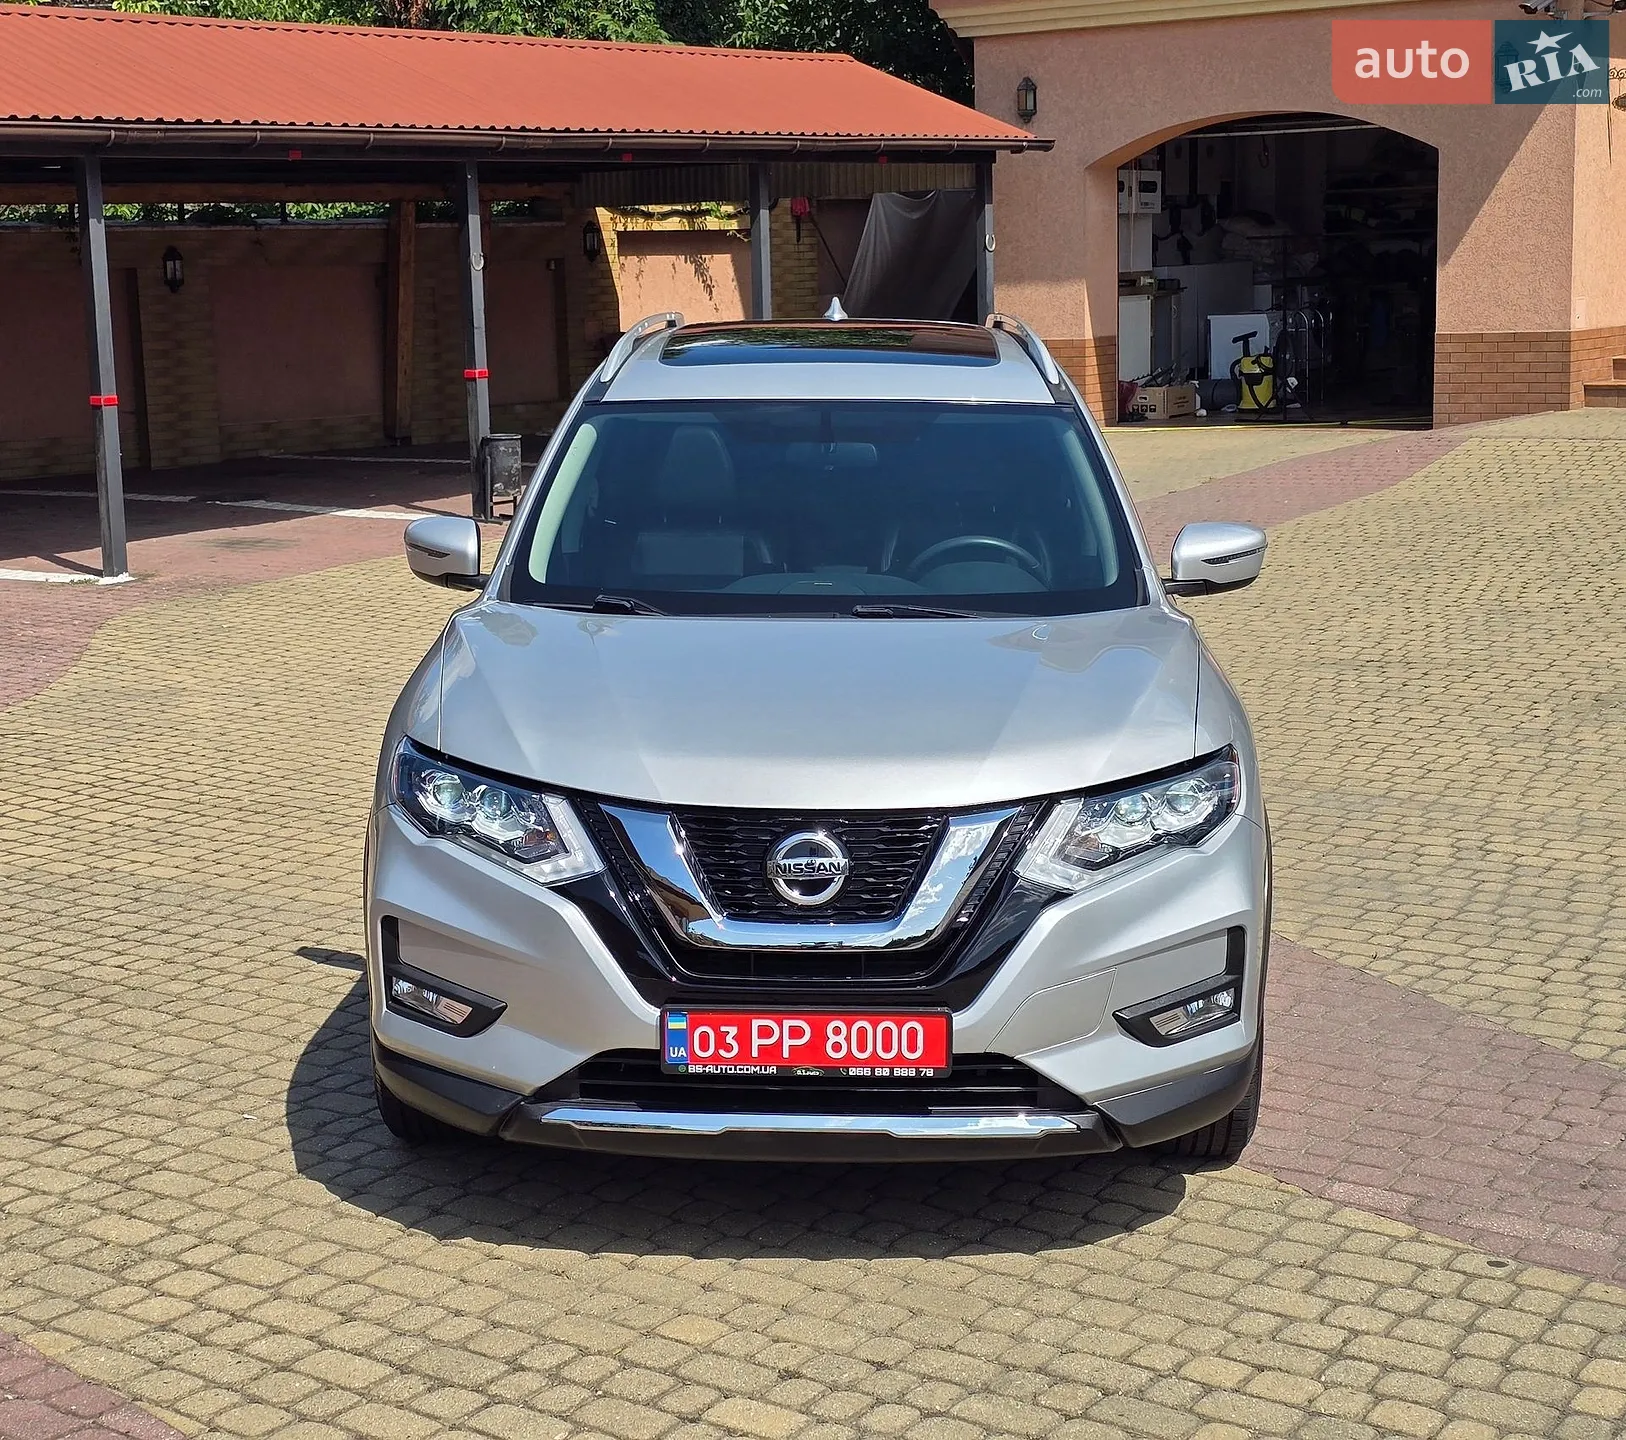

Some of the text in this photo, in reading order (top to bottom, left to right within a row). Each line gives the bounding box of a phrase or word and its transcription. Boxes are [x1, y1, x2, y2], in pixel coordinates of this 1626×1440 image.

[775, 861, 841, 874] NISSAN
[693, 1018, 924, 1060] 03 PP 8000
[669, 1046, 687, 1058] UA
